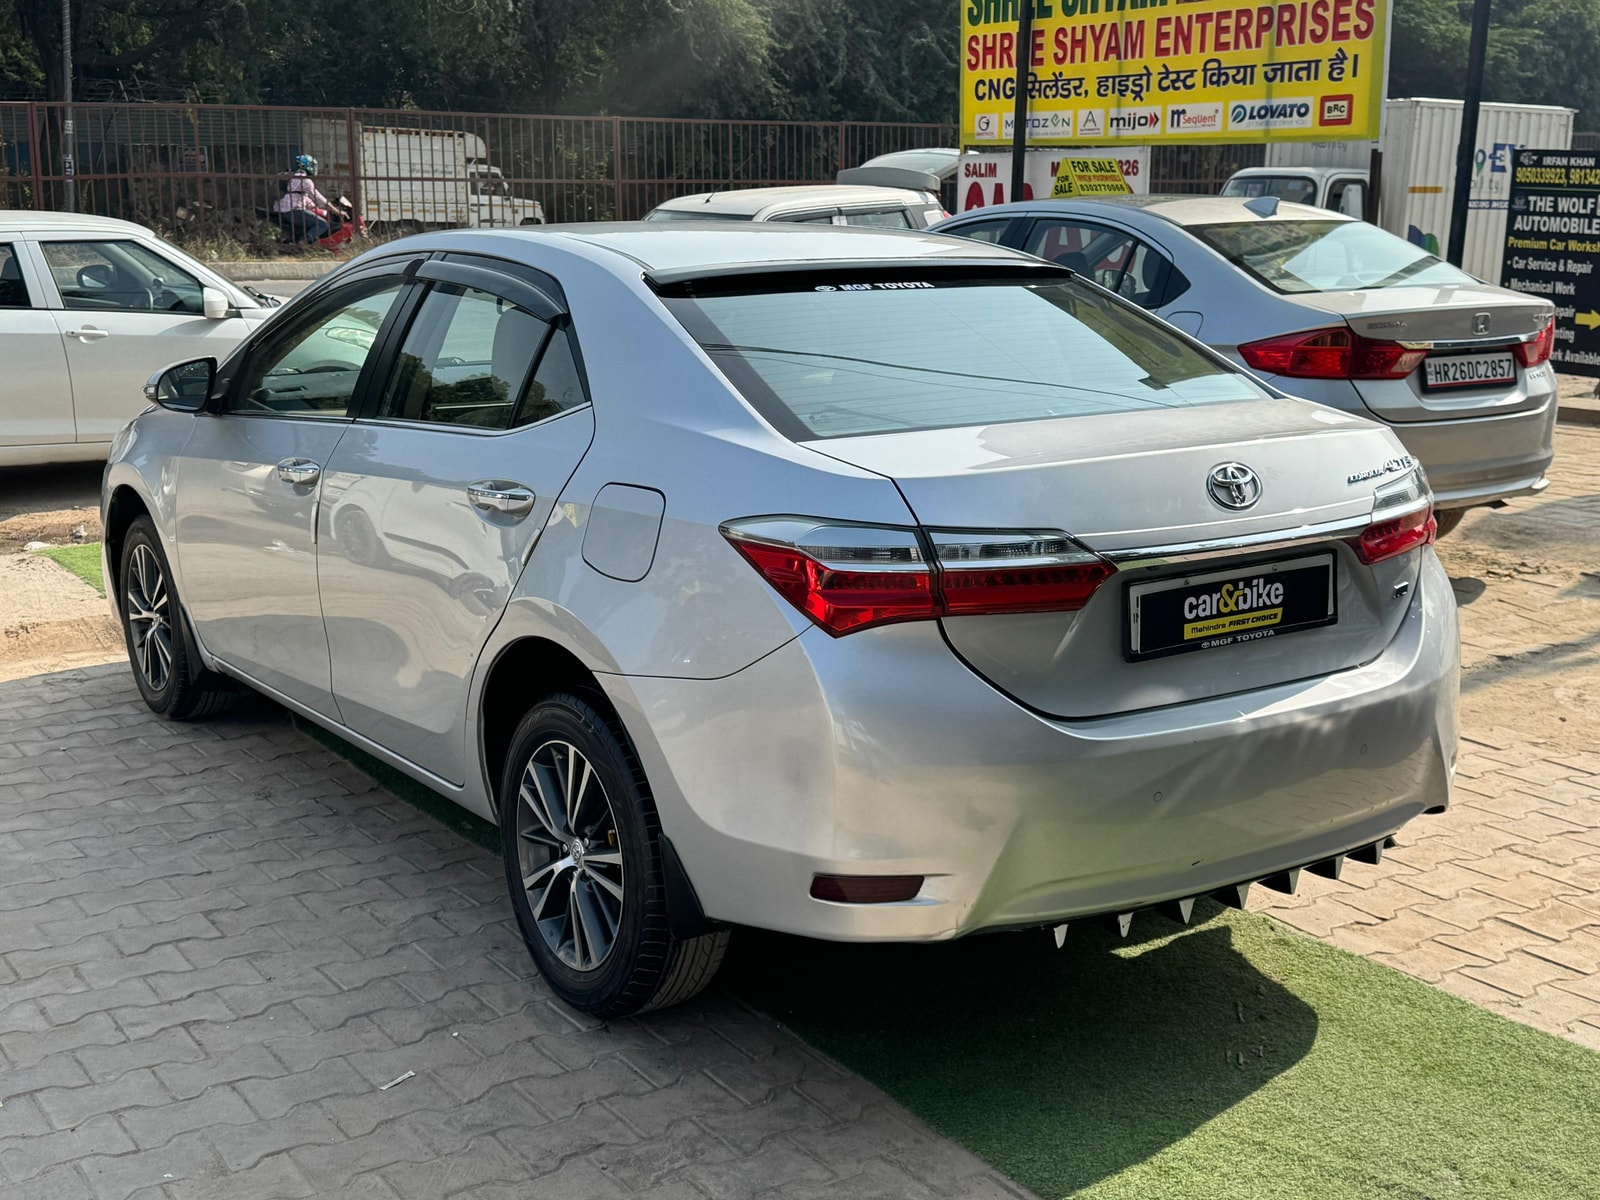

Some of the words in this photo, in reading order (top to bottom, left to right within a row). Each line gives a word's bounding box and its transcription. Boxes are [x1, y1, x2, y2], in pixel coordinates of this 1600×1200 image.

[967, 29, 1046, 72] SHRE
[1053, 19, 1146, 66] SHYAM
[1154, 0, 1376, 58] ENTERPRISES
[974, 77, 1016, 101] CNG
[1096, 65, 1153, 101] हाइड्रो
[1157, 64, 1198, 92] टेस्ट
[1202, 58, 1257, 88] किया
[1262, 59, 1322, 83] जाता
[1248, 103, 1310, 120] LOVATO
[1327, 103, 1346, 114] BRC
[1004, 113, 1071, 129] MTOZEN
[1109, 112, 1149, 130] mijo
[964, 162, 997, 178] SALIM
[1071, 160, 1092, 173] FOR
[1092, 161, 1117, 173] SALE
[1542, 156, 1568, 166] IRFAN
[1569, 156, 1596, 167] KHAN
[1057, 175, 1070, 183] FOR
[1054, 182, 1073, 195] SALE
[1528, 195, 1555, 212] THE
[1557, 196, 1596, 214] WOLF
[1513, 215, 1600, 234] AUTOMOBILE
[1508, 236, 1548, 250] Premium
[1549, 238, 1567, 251] Car
[1512, 256, 1527, 269] Car
[1527, 257, 1557, 272] Service
[1558, 259, 1565, 272] &
[1566, 260, 1593, 276] Repair
[838, 283, 874, 292] MGF
[874, 281, 936, 290] TOYOTA
[1510, 278, 1554, 293] Mechanical
[1555, 281, 1576, 296] Work
[1555, 305, 1576, 320] epair
[1433, 358, 1513, 384] HR26DC2857
[1183, 578, 1284, 620] car&bike
[1191, 623, 1227, 635] Mahindra
[1228, 617, 1251, 628] FIRST
[1250, 612, 1279, 624] CHOICE
[1210, 637, 1234, 648] MGF
[1235, 629, 1275, 643] TOYOTA
